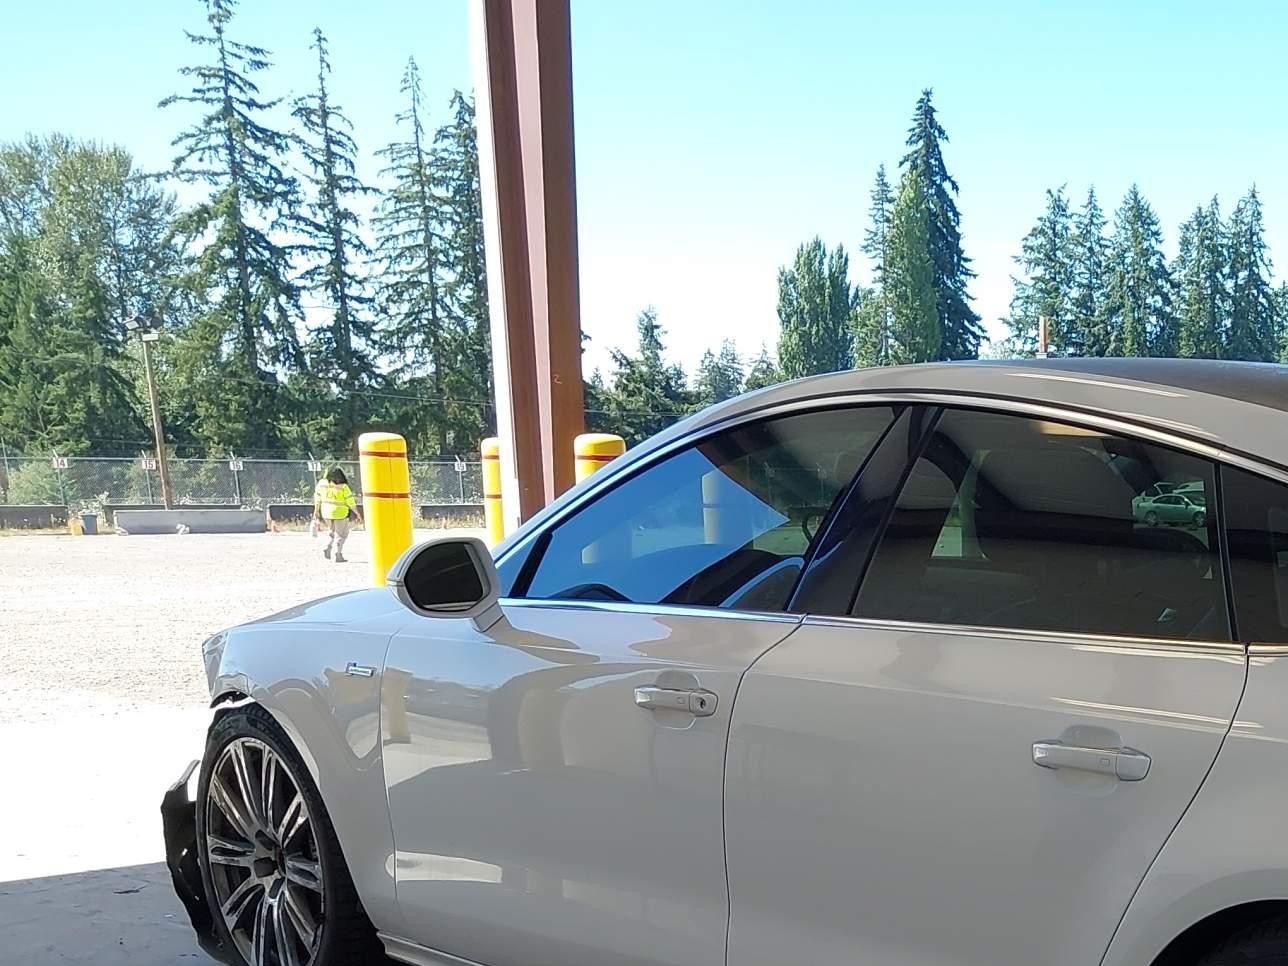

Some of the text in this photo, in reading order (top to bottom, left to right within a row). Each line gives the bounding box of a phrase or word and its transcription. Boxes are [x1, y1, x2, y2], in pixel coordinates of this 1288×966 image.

[56, 459, 66, 468] 14
[144, 460, 154, 469] 15
[232, 461, 241, 470] 16
